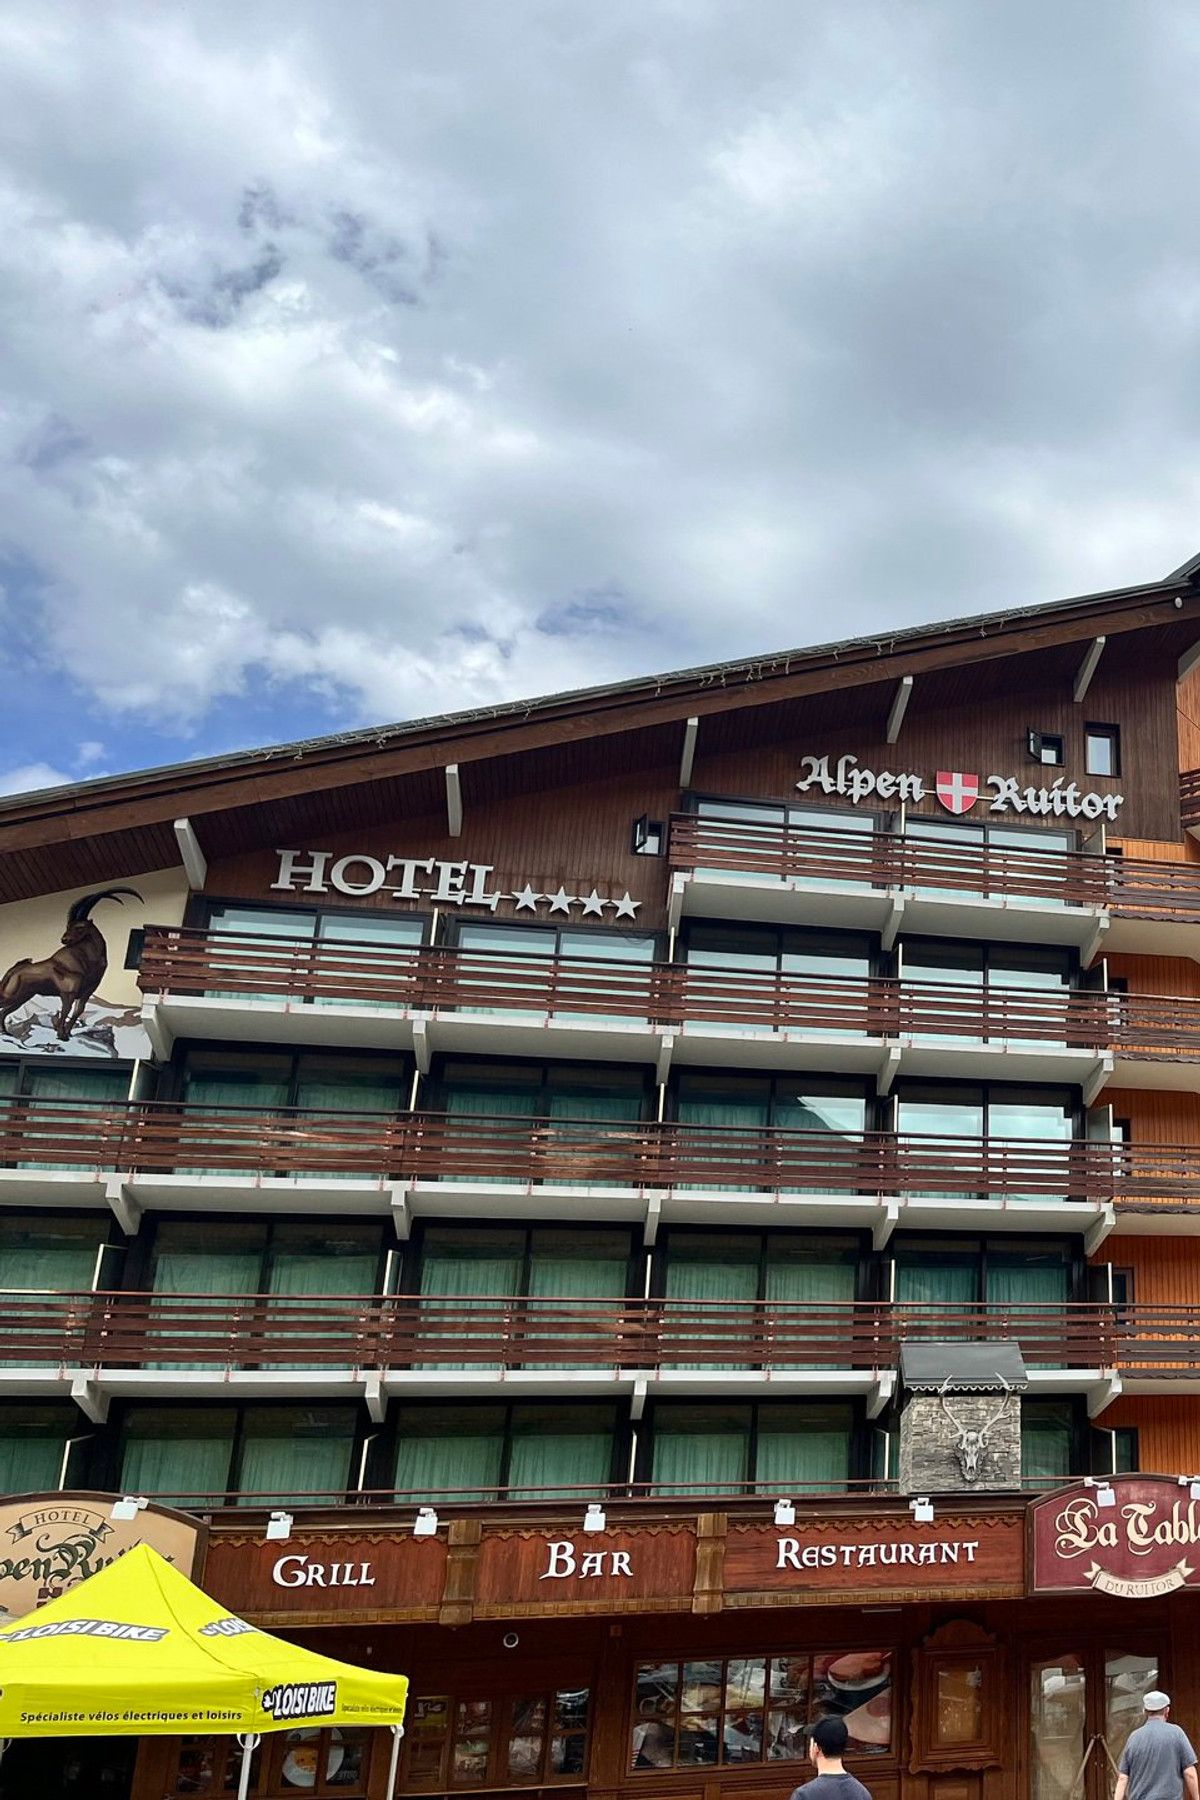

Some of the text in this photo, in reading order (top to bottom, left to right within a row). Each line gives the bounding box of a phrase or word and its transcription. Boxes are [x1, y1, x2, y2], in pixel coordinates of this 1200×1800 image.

[796, 755, 1124, 822] Alpen Ruitor
[270, 849, 501, 911] HOTEL
[35, 1510, 90, 1525] HOTEL
[1055, 1497, 1119, 1558] La
[539, 1542, 633, 1580] BAR
[776, 1538, 979, 1568] RESTAURANT
[273, 1556, 376, 1588] GRILL
[1105, 1579, 1125, 1594] DU
[20, 1709, 243, 1724] Spécialiste vélos électriques et loisirs
